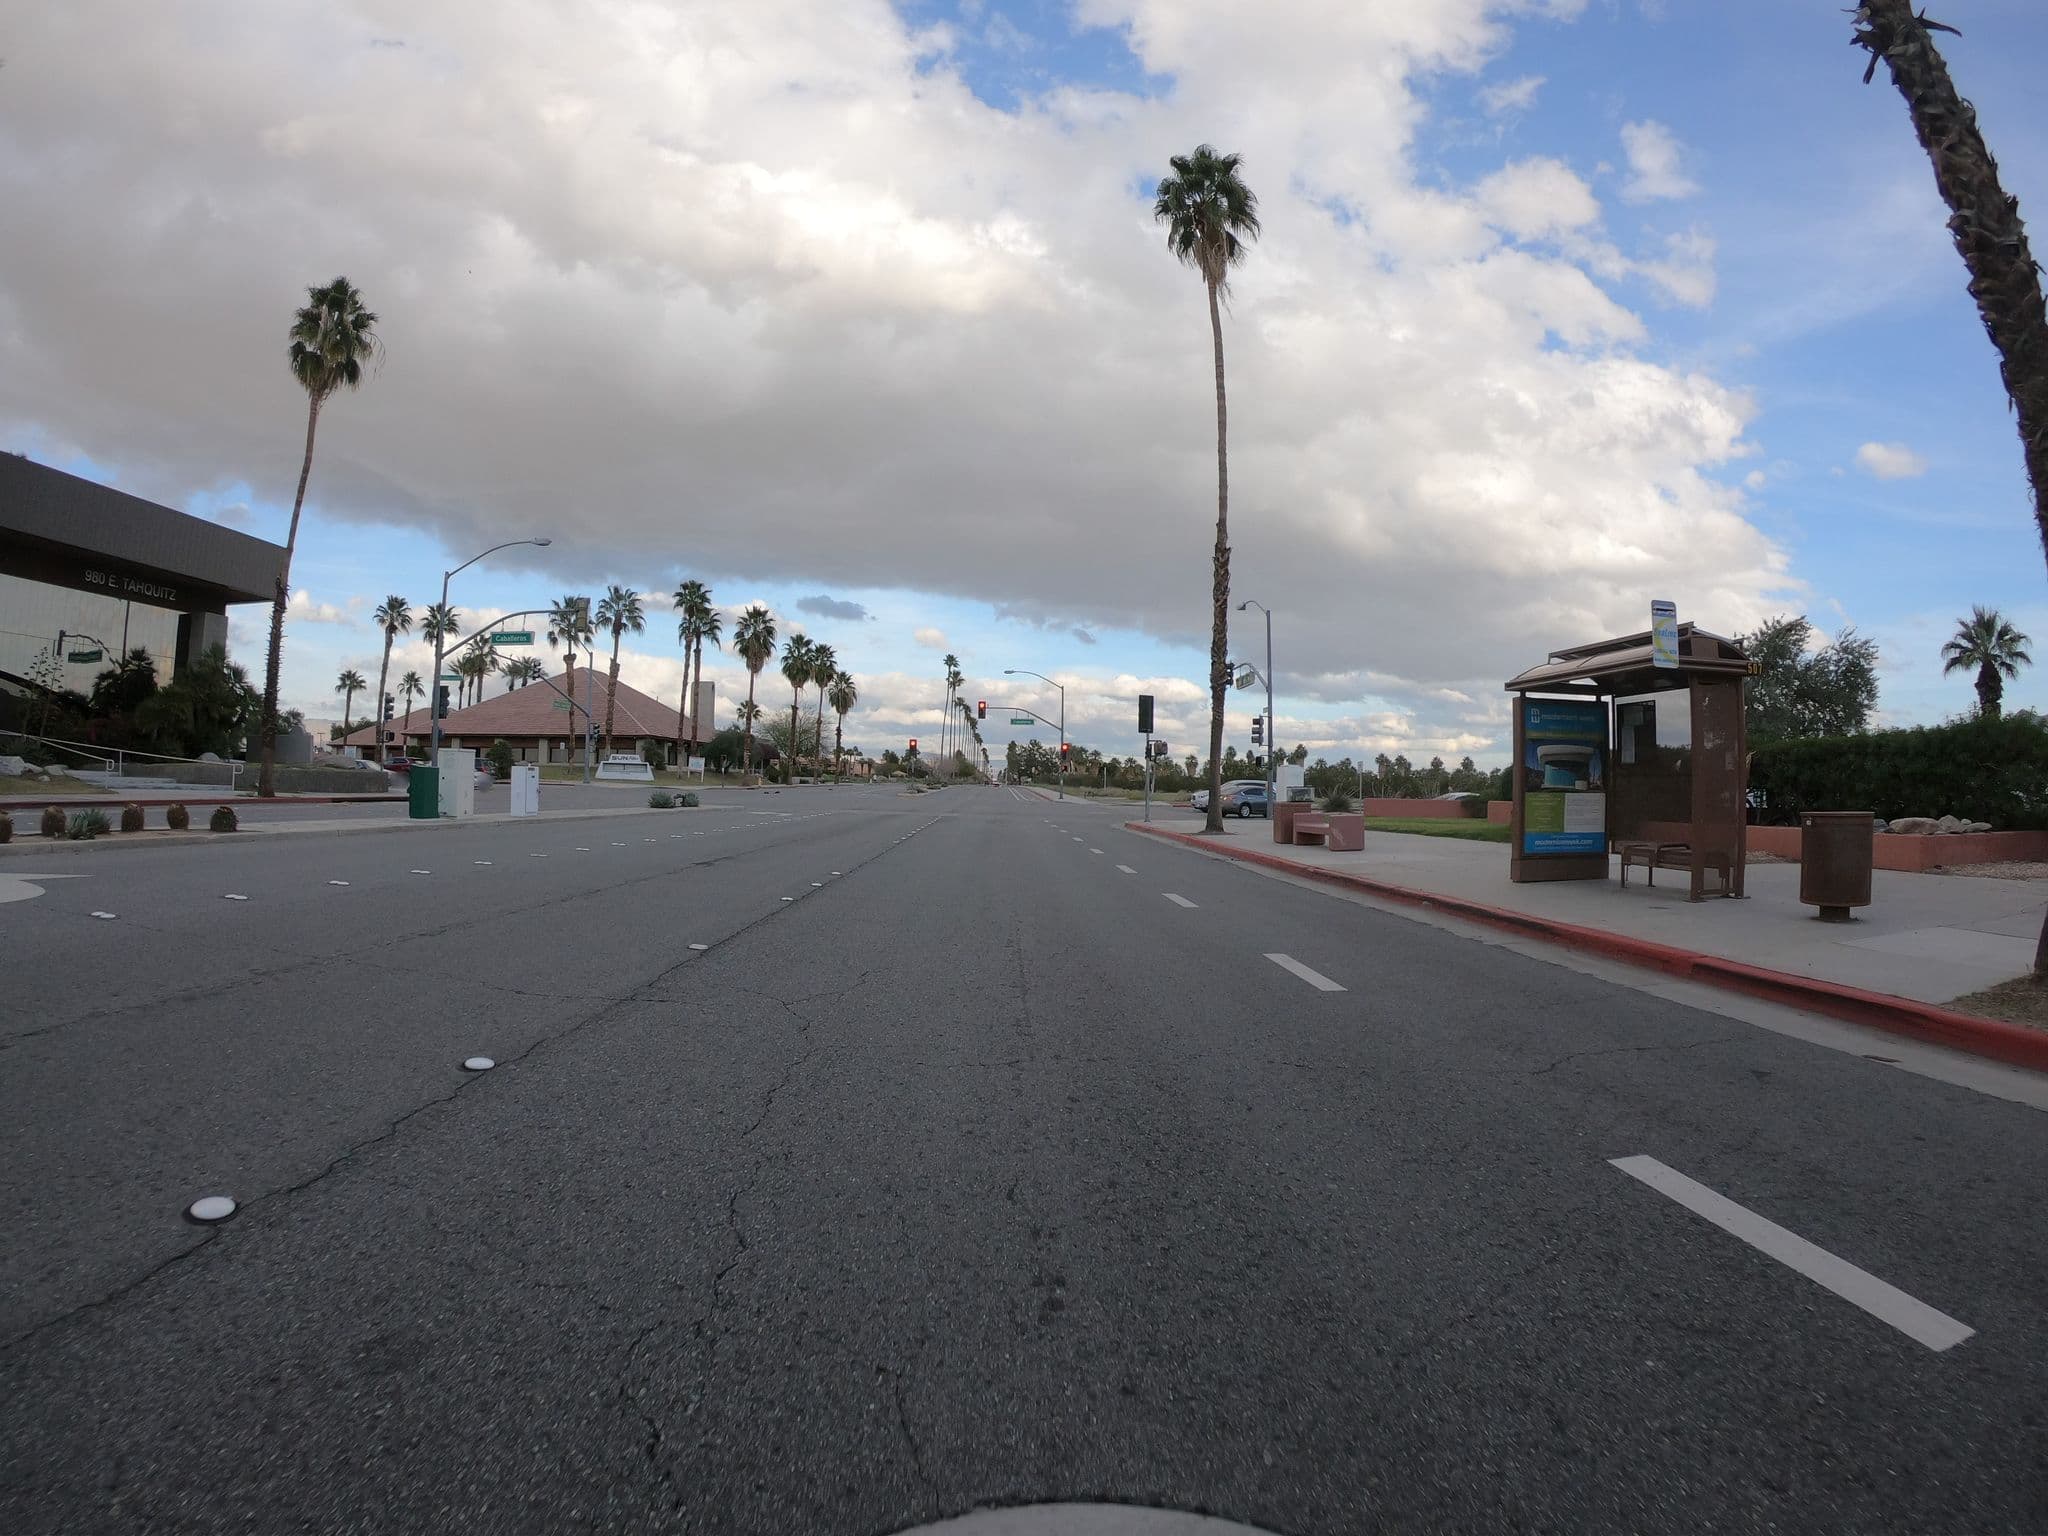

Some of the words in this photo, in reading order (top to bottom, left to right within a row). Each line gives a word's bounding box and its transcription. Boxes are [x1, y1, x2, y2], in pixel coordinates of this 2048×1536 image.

[85, 570, 105, 585] 980
[108, 575, 119, 588] E.
[122, 577, 176, 601] TAHQUITZ
[1747, 663, 1762, 674] 507
